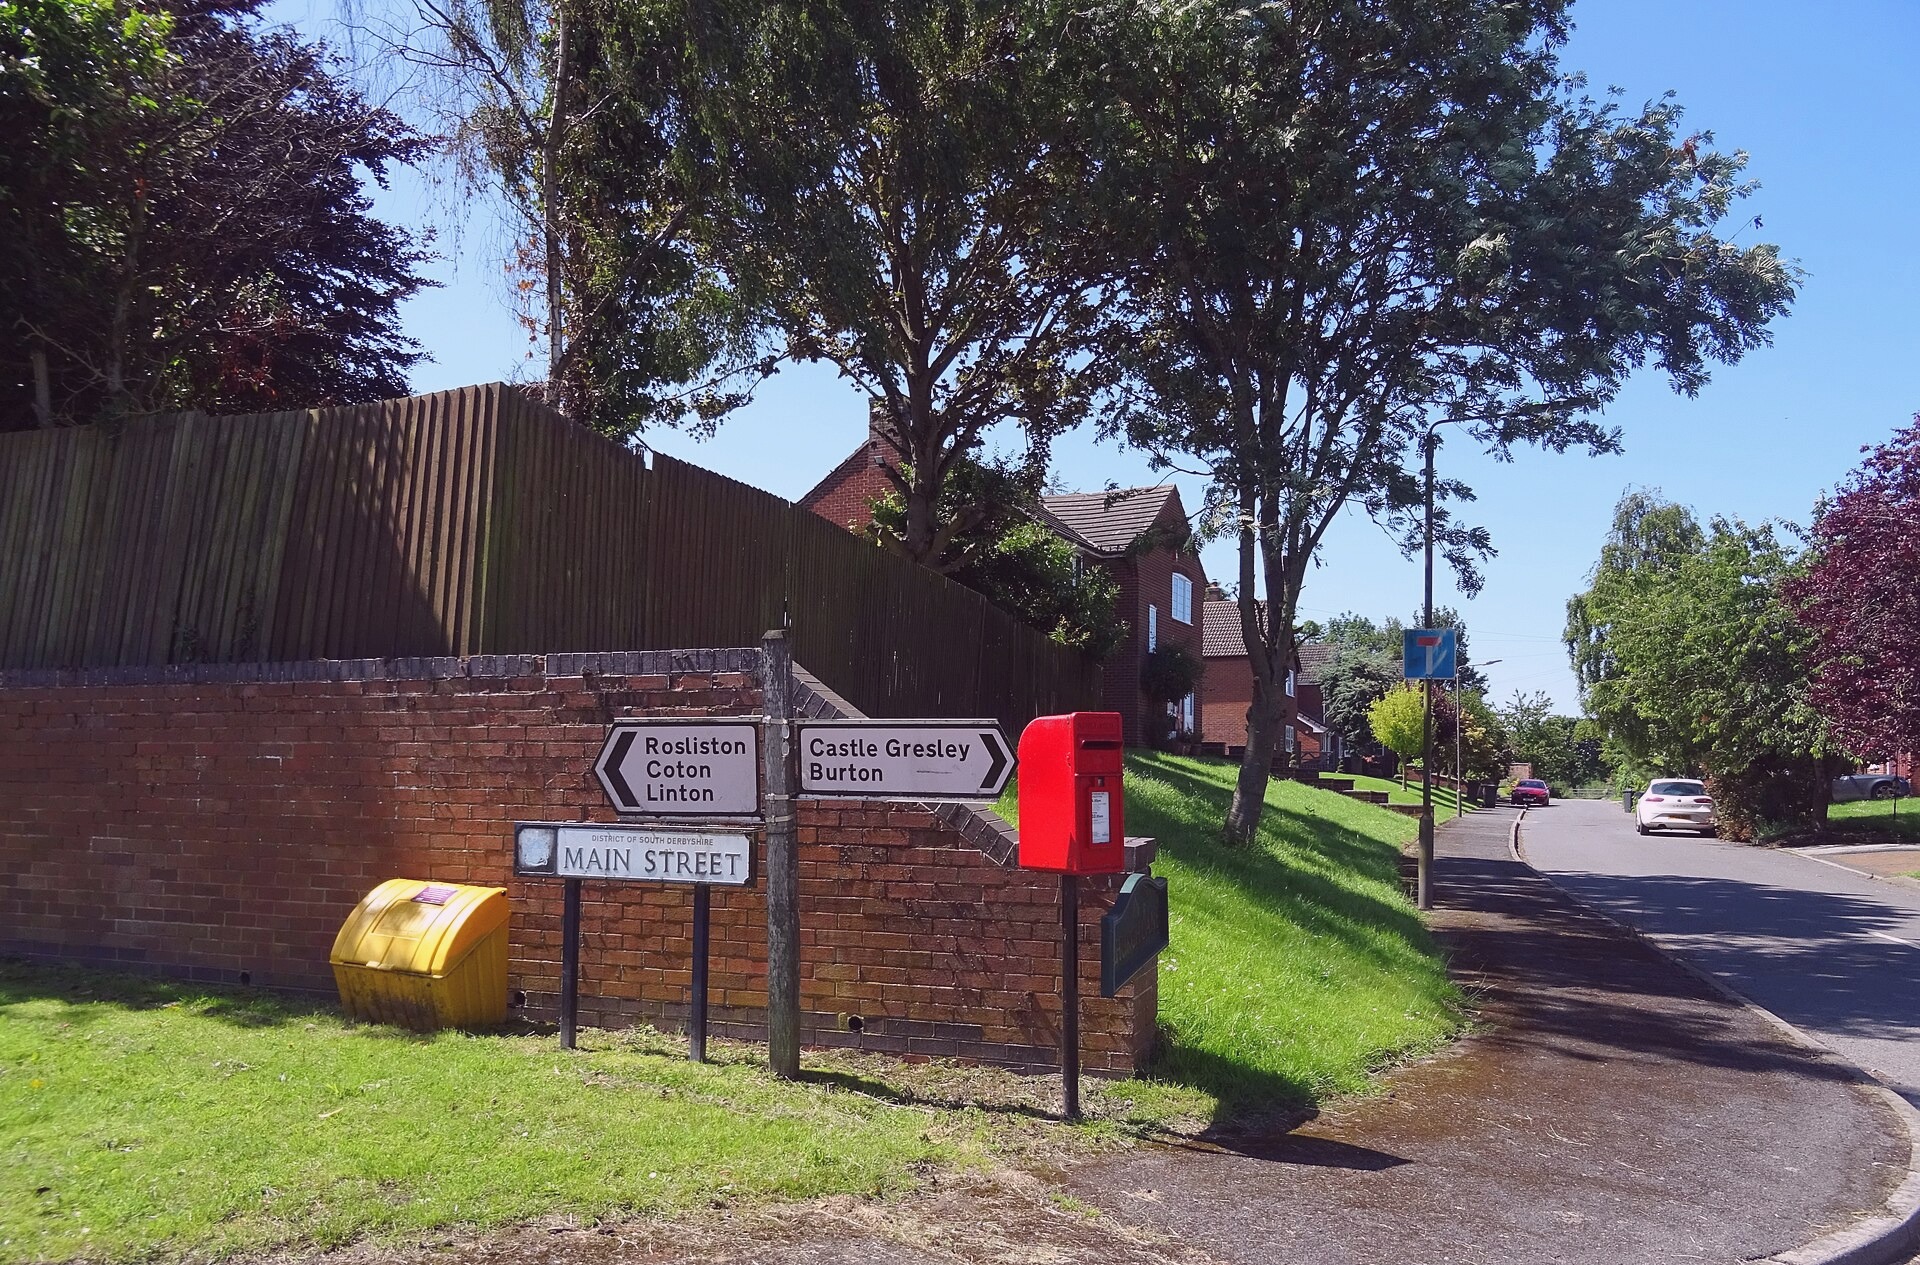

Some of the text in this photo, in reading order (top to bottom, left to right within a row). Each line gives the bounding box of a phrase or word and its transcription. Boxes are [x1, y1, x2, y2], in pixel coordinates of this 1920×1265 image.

[645, 737, 746, 755] Rosliston
[809, 738, 970, 762] Castle Gresley
[646, 760, 711, 778] Coton
[810, 763, 883, 781] Burton
[647, 784, 714, 801] Linton
[592, 834, 714, 846] DISTRICT OF SOUTH DERBYSHIRE
[563, 847, 741, 876] MAIN STREET
